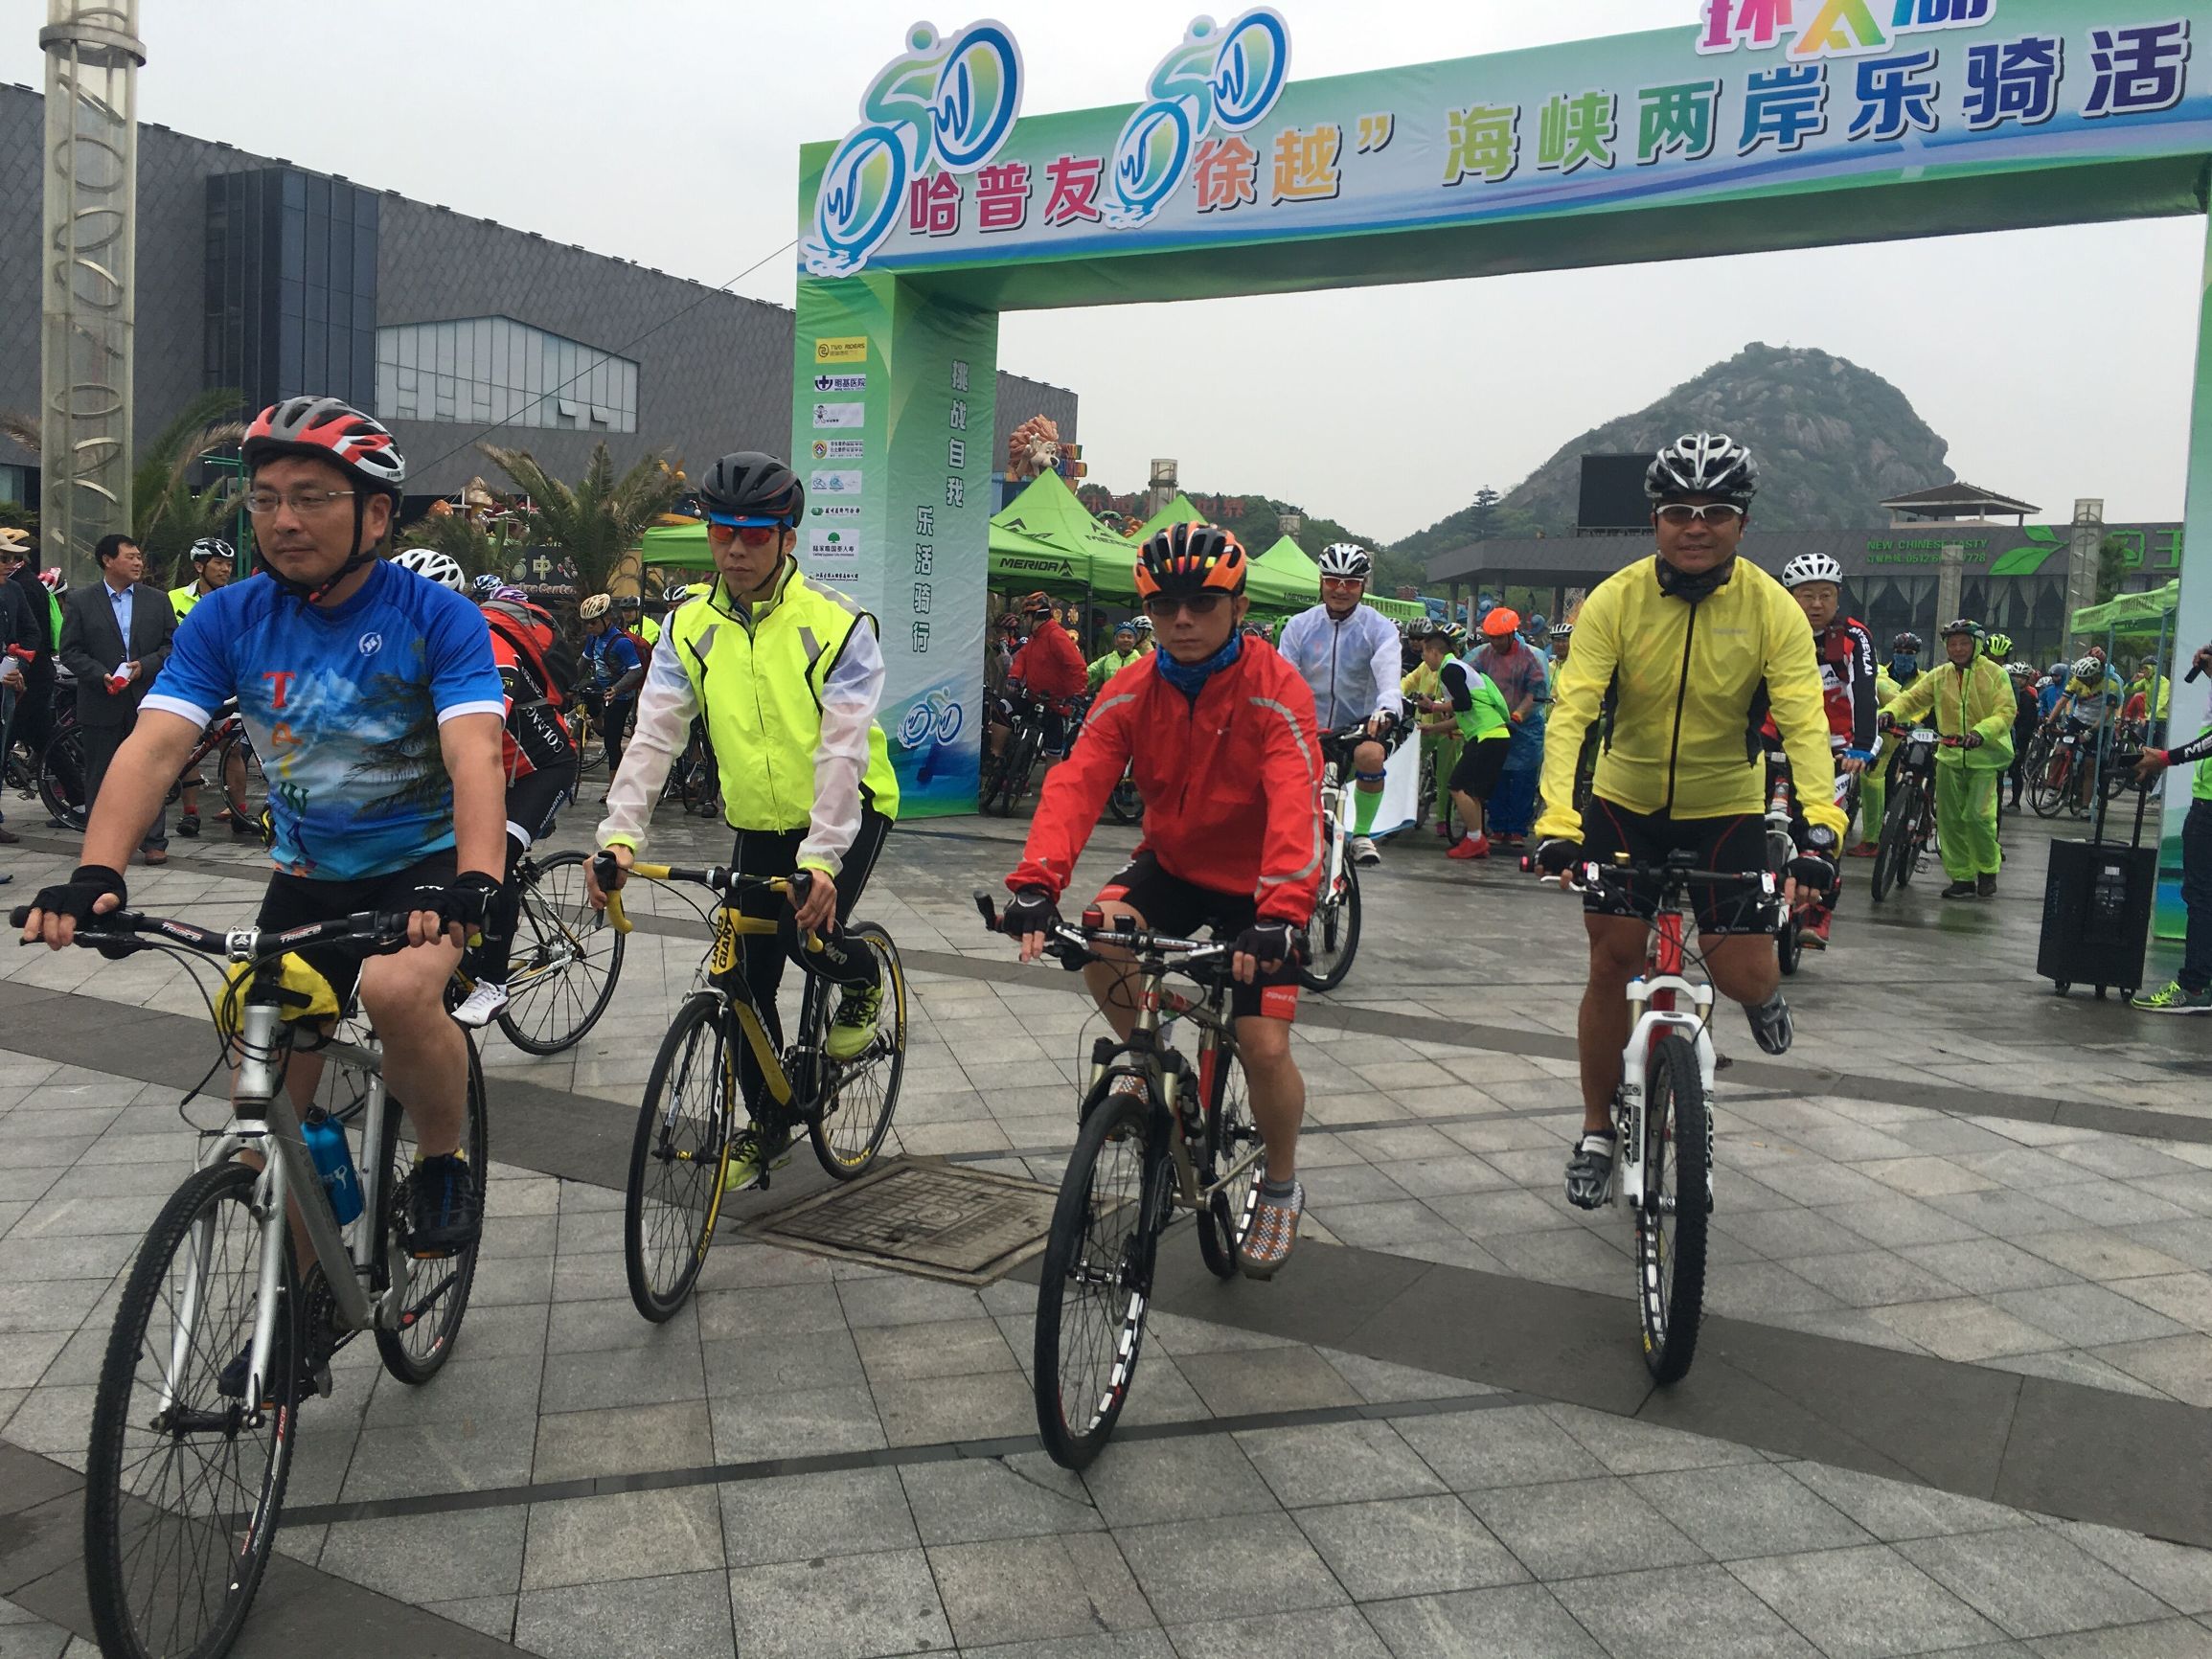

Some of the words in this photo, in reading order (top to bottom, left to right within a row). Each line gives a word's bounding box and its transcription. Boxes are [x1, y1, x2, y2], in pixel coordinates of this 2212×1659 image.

[909, 155, 1104, 235] 哈普友
[1443, 20, 2187, 182] 海峡两岸乐骑活
[946, 359, 969, 508] 挑战自我
[911, 505, 934, 653] 乐活骑行
[999, 557, 1059, 572] MERIDA
[1867, 540, 1894, 551] NEW
